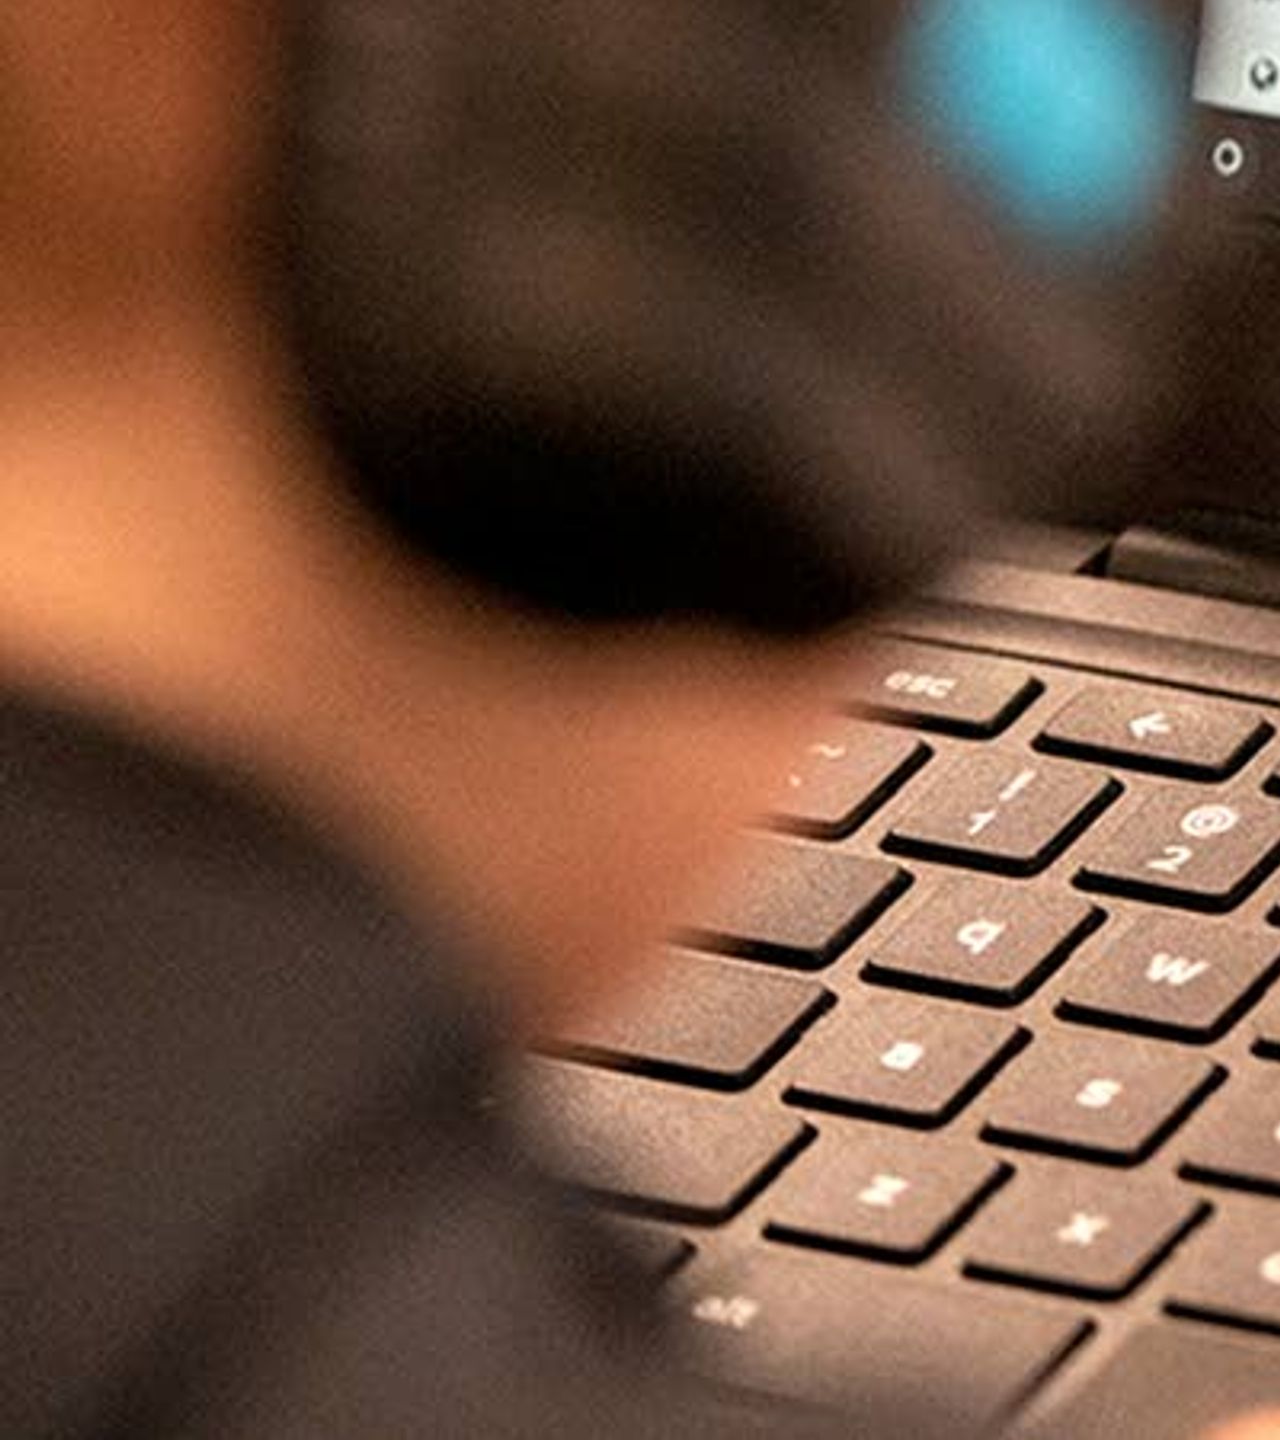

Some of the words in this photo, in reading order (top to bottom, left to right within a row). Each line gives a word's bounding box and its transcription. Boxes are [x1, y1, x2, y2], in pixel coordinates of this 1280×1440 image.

[884, 671, 957, 698] esc
[1180, 803, 1239, 837] @
[1147, 846, 1194, 872] 2
[956, 920, 1005, 954] q
